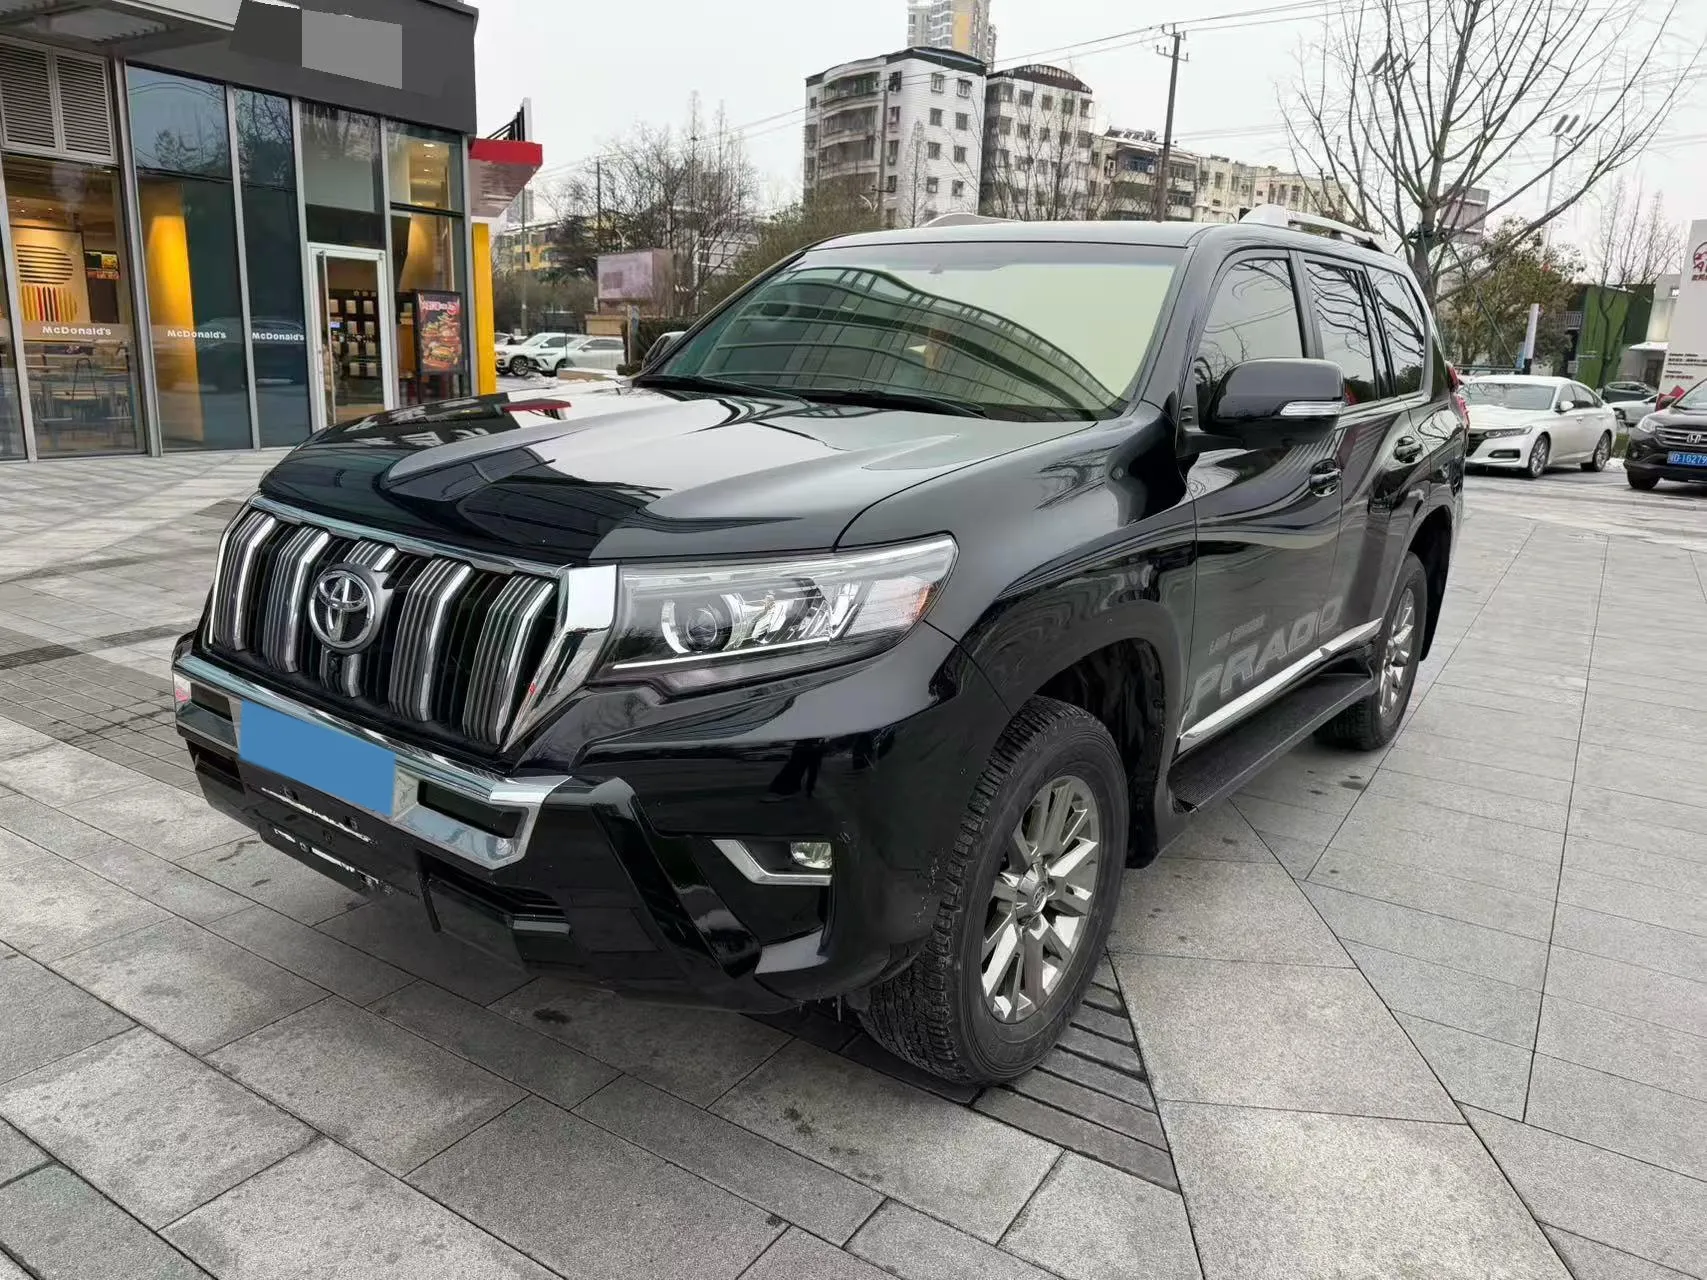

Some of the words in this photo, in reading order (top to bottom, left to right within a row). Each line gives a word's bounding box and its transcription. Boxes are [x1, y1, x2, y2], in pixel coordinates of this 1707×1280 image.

[42, 326, 112, 336] McDonald's
[167, 329, 227, 340] McDonald's
[252, 331, 305, 342] McDonald's
[1182, 596, 1343, 721] PRADO
